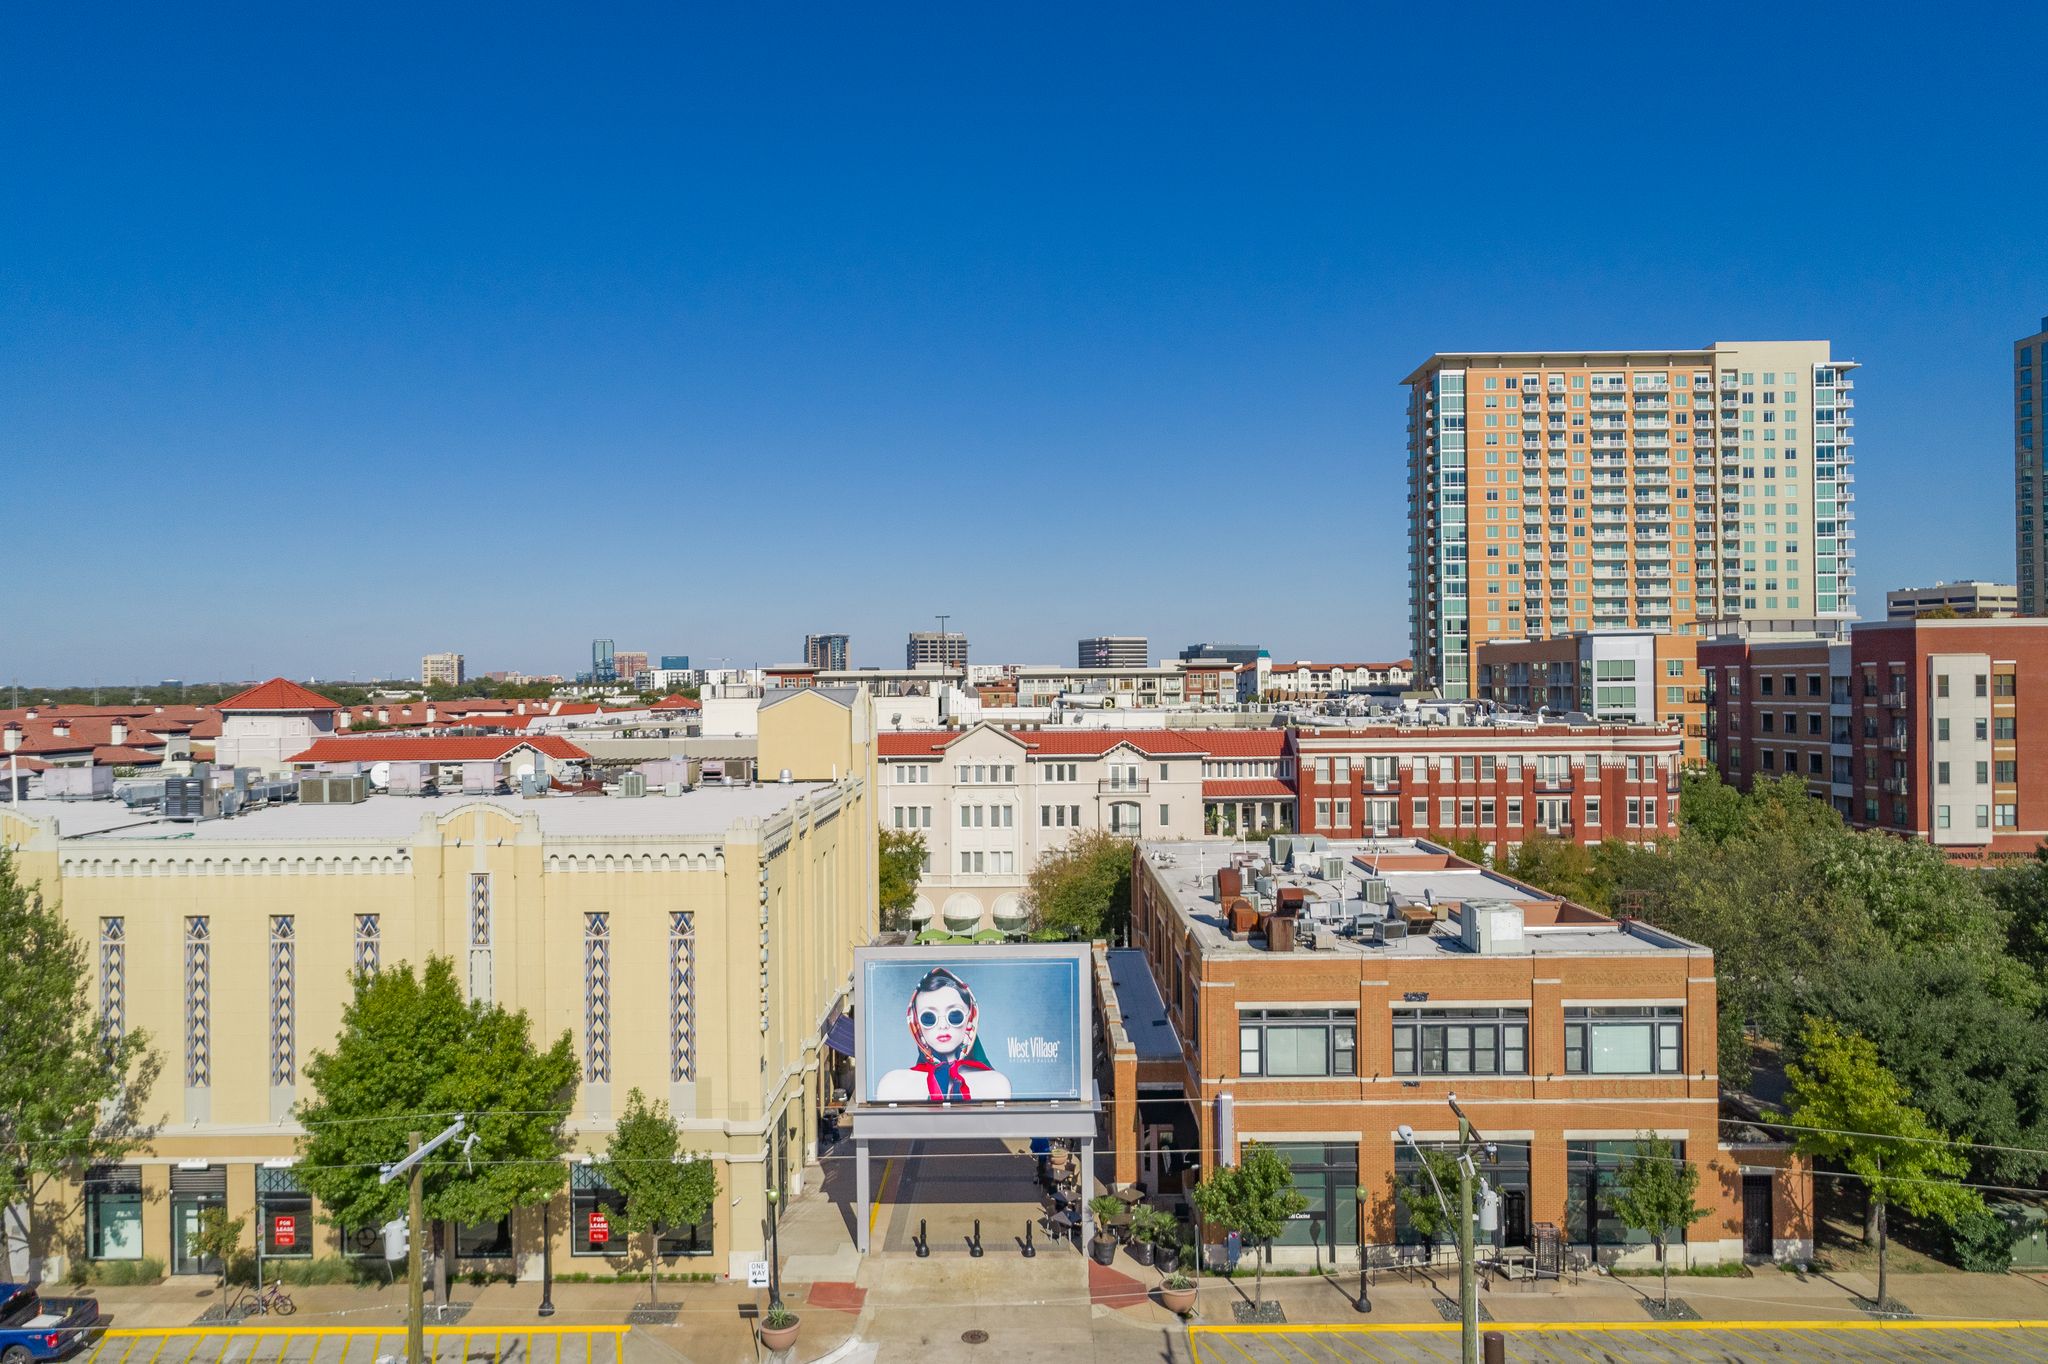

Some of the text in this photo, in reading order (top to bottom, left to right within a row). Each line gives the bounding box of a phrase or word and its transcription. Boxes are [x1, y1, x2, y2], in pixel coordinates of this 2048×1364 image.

[1007, 1036, 1058, 1058] West Village
[751, 1262, 766, 1270] ONE
